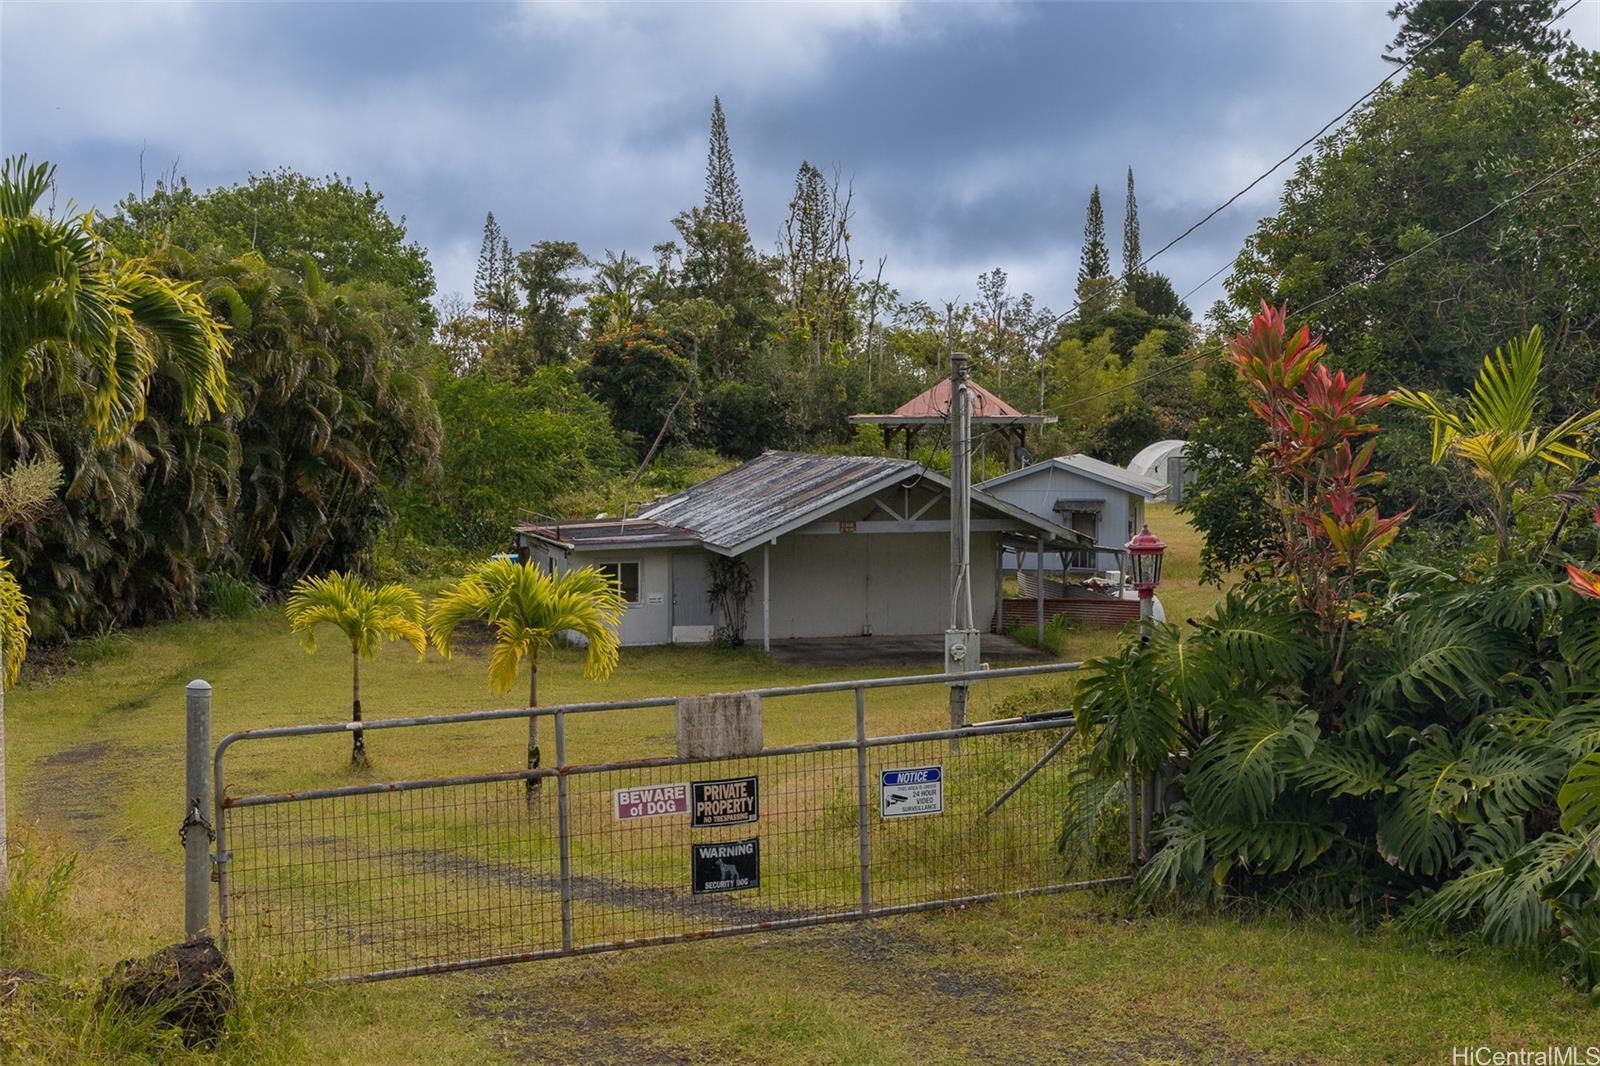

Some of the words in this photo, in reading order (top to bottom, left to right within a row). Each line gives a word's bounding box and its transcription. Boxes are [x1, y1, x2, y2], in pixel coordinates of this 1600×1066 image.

[897, 771, 928, 783] NOTICE
[619, 786, 685, 805] BEWARE
[704, 782, 748, 801] PRIVATE
[912, 790, 920, 798] 24
[697, 797, 754, 817] PROPERTY
[916, 797, 933, 805] VIDEO
[630, 803, 643, 816] of
[647, 800, 676, 815] DOG
[713, 812, 749, 823] TRESPASSING
[700, 844, 753, 858] WARNING
[704, 879, 735, 890] SECURITY
[736, 878, 748, 886] DOG
